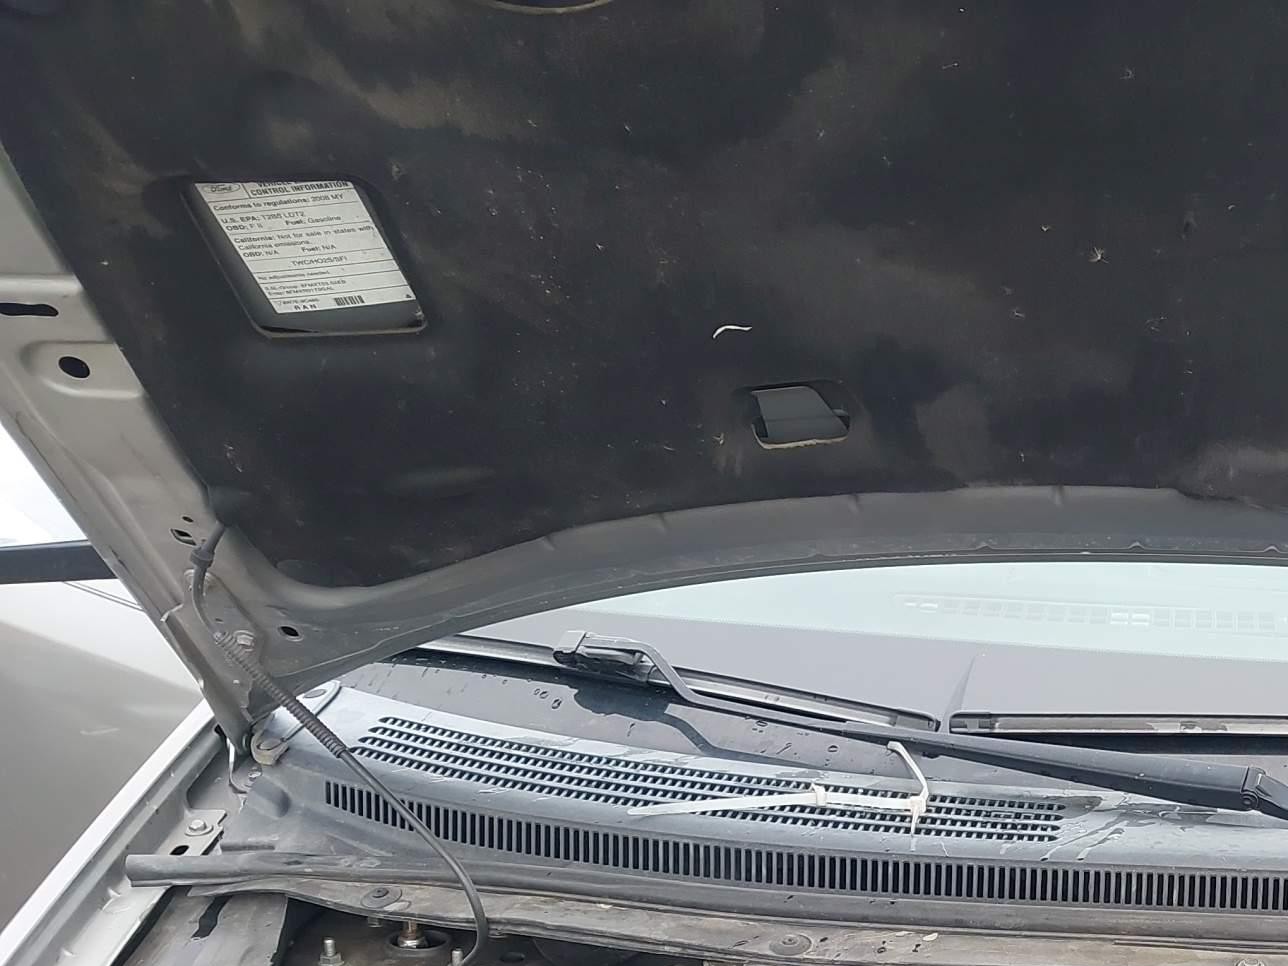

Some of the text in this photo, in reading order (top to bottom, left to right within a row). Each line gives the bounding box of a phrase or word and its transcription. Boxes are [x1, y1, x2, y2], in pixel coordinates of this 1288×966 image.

[250, 182, 349, 197] CONTROL INFORMATION
[214, 203, 252, 211] Conforms
[263, 198, 310, 207] regulations:
